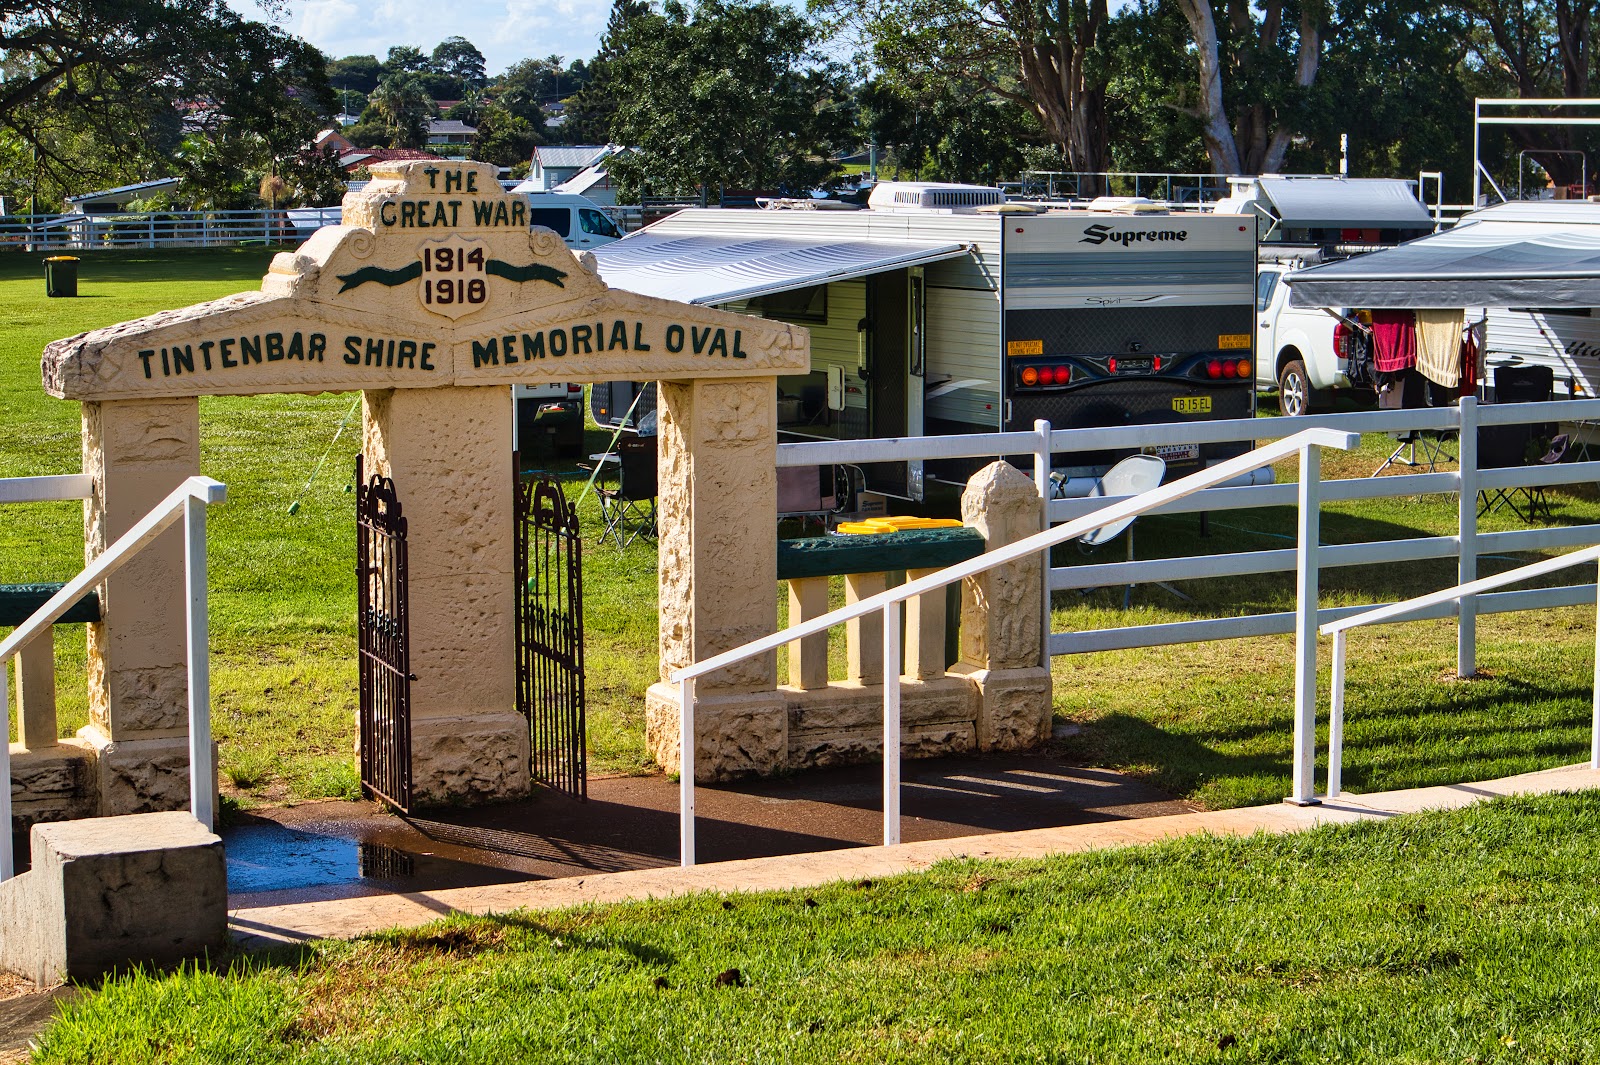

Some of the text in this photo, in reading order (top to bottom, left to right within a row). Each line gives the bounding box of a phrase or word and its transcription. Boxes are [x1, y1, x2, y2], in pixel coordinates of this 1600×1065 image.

[423, 165, 478, 193] THE
[381, 200, 526, 228] GREAT WAR
[1078, 224, 1188, 247] Supreme
[424, 247, 485, 272] 1914
[425, 279, 486, 304] 1918
[1084, 296, 1128, 307] Spirit
[138, 320, 747, 379] TINTENBAR SHIRE MEMORIAL OVAL
[1156, 445, 1198, 454] CARAVANS
